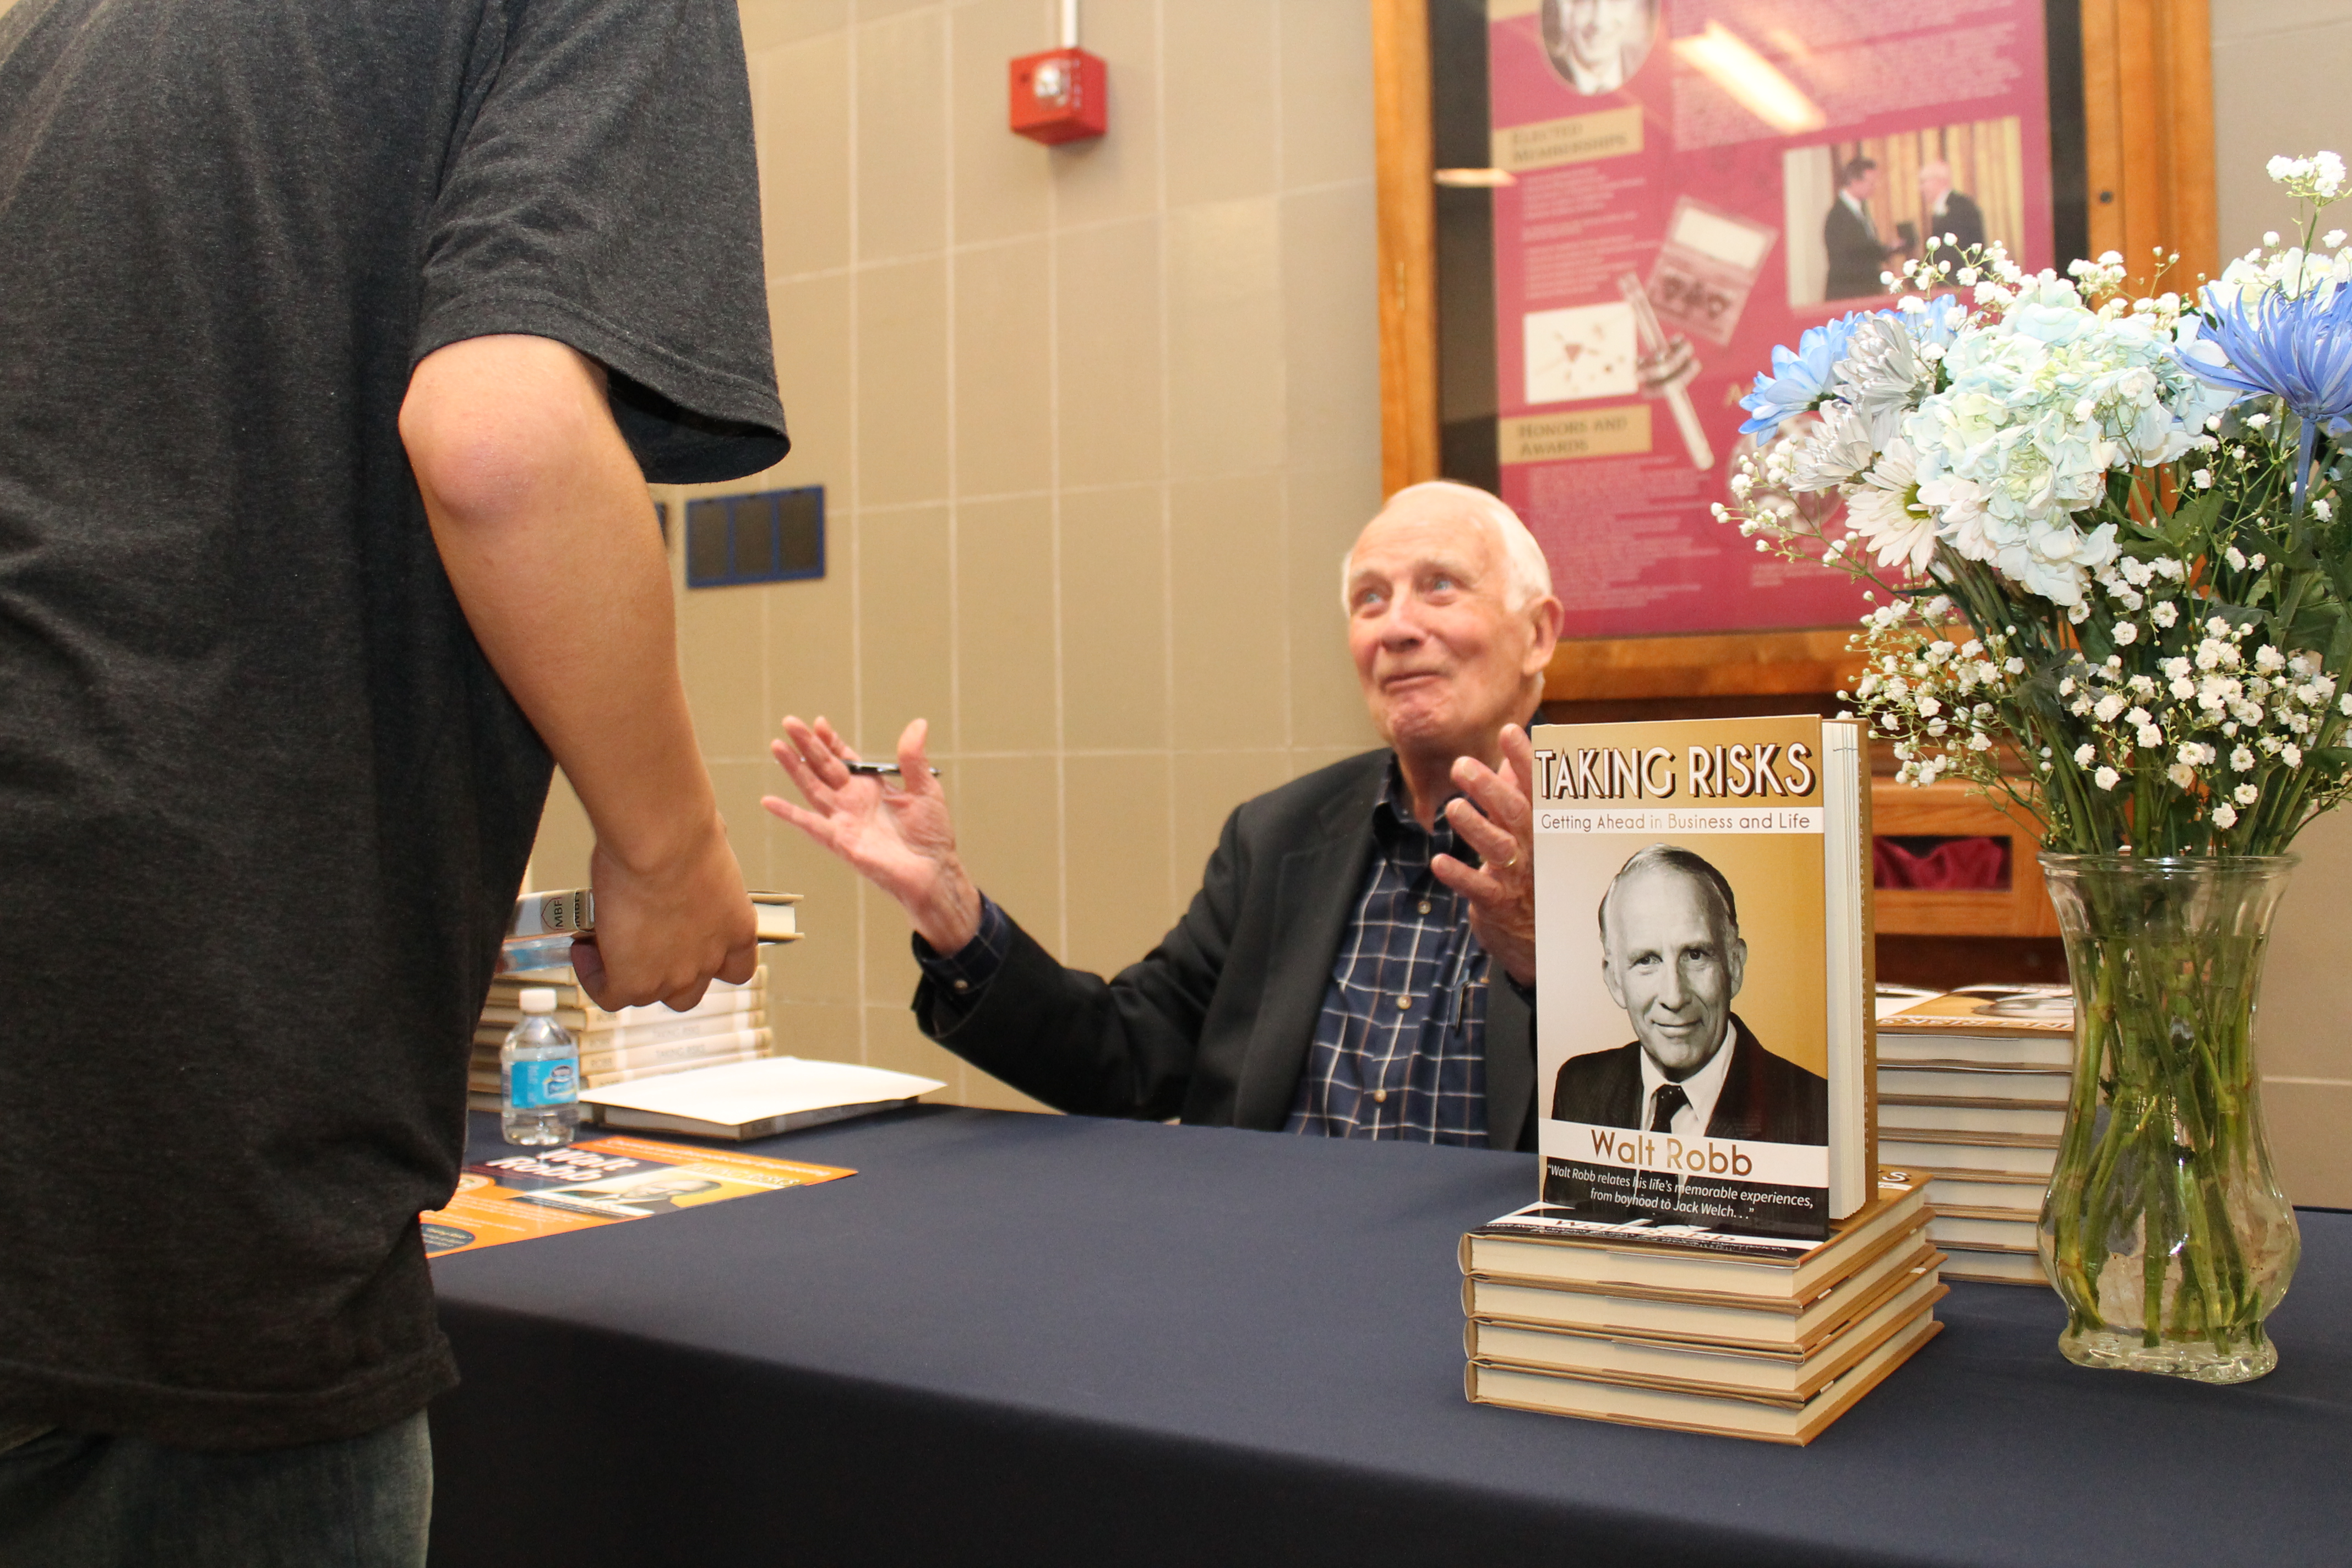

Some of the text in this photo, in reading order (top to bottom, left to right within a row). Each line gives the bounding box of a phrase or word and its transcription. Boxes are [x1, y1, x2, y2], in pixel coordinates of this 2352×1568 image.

[1534, 741, 1817, 799] TAKING RISKS
[1541, 813, 1810, 832] Getting Ahead in Business and Life
[1591, 1129, 1752, 1176] Walt Robb
[485, 1156, 603, 1182] Robb
[1547, 1164, 1814, 1210] “Walt Robb relates his life’s memorable experiences,
[1590, 1188, 1613, 1202] from
[1615, 1190, 1658, 1208] boyhood
[1660, 1198, 1672, 1210] to
[1673, 1199, 1699, 1213] Jack
[1555, 1220, 1629, 1232] Walt
[1642, 1228, 1735, 1242] Robb
